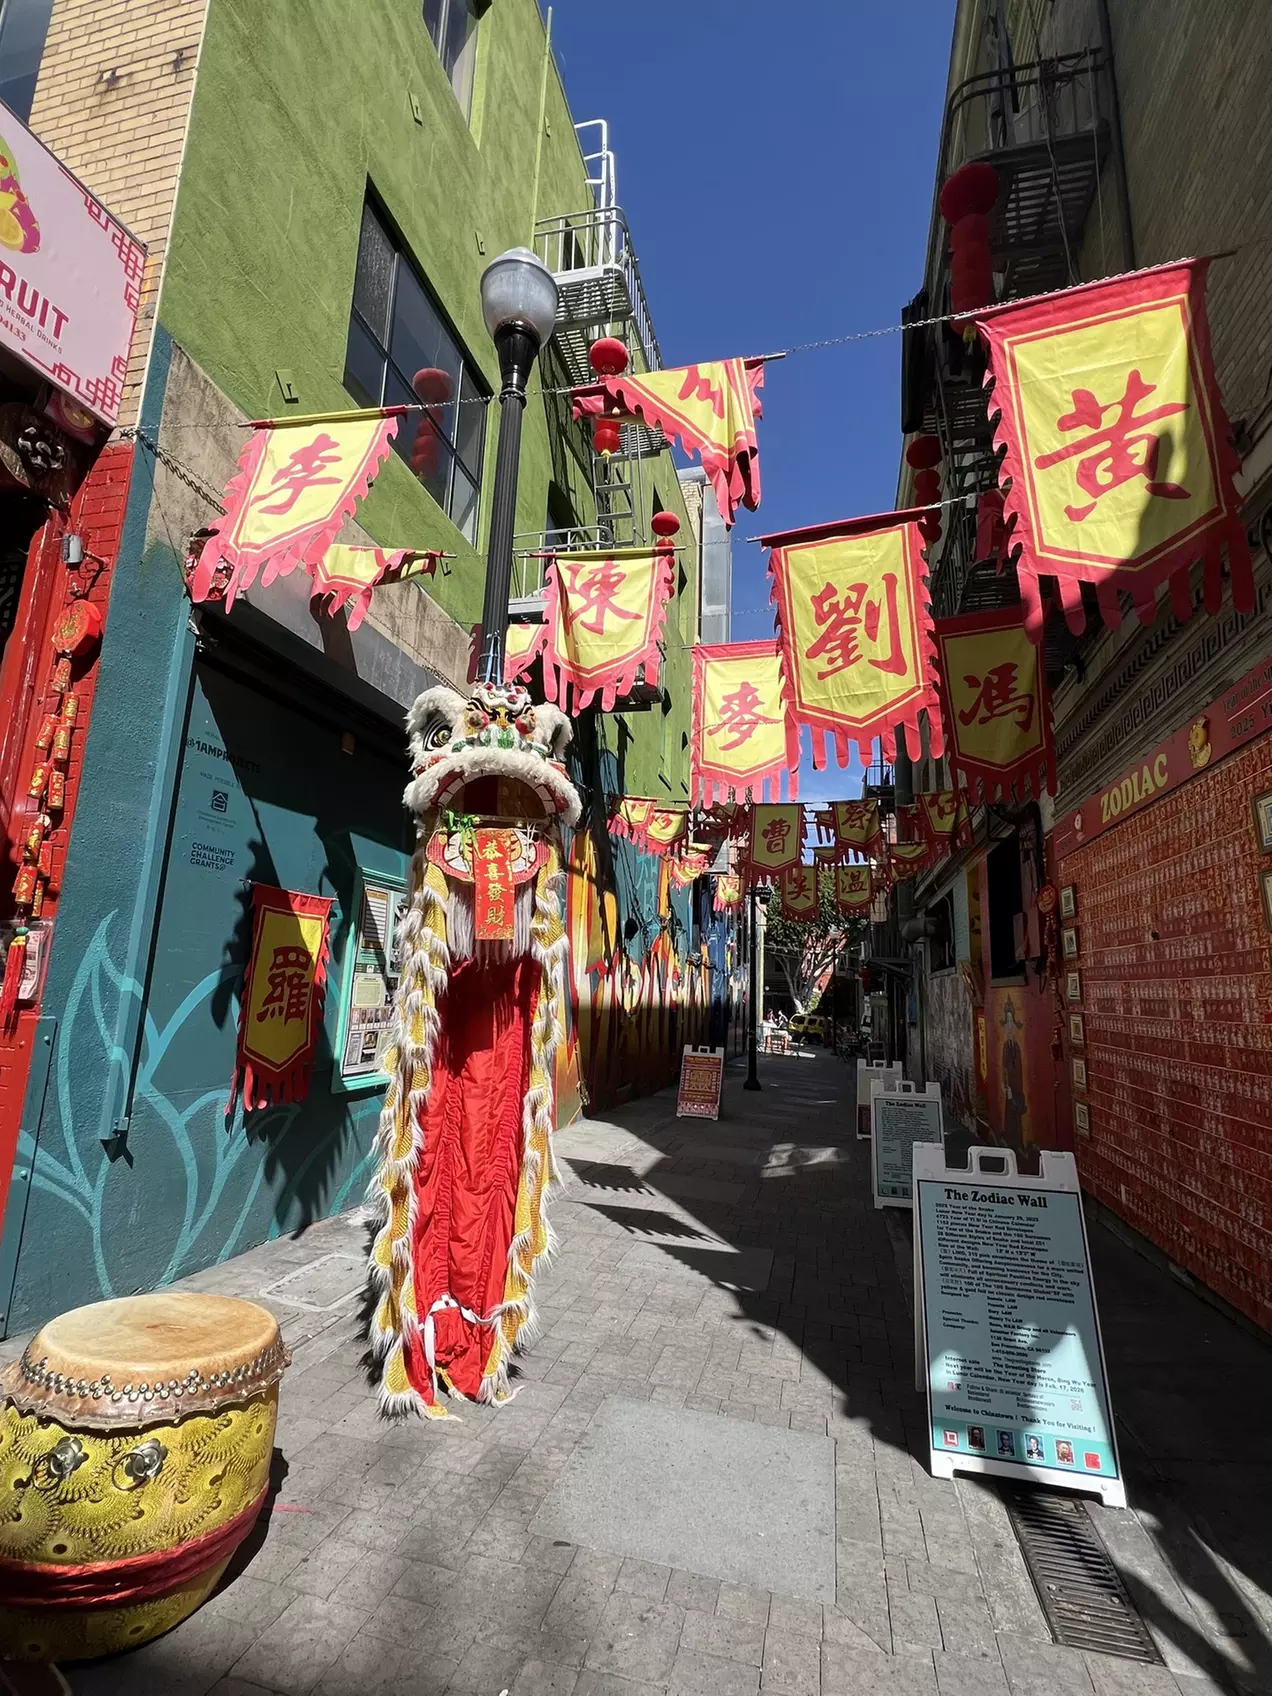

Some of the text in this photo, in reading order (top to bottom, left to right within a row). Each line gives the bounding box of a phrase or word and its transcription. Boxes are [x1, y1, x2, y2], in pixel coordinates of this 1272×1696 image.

[5, 304, 63, 355] HERBAL DRINKS
[250, 433, 343, 515] 李
[806, 573, 907, 681] 劉
[959, 662, 1034, 733] 馮
[707, 682, 784, 751] 麥
[1231, 714, 1255, 739] 2025
[1100, 753, 1168, 823] ZODIAC
[192, 842, 235, 857] COMMUNITY
[761, 819, 791, 854] 曹
[190, 858, 221, 871] GRANTS
[191, 850, 235, 866] CHALLENGE
[482, 840, 507, 926] 恭喜發財
[256, 946, 314, 1026] 羅
[944, 1188, 1048, 1208] The Zodiac Wall
[1004, 1363, 1030, 1373] Greeting
[1026, 1373, 1036, 1381] the
[1083, 1382, 1097, 1390] Year
[944, 1404, 972, 1414] Welcome
[980, 1410, 1014, 1420] Chinatown
[1020, 1415, 1041, 1424] Thank
[1067, 1422, 1091, 1433] Visiting
